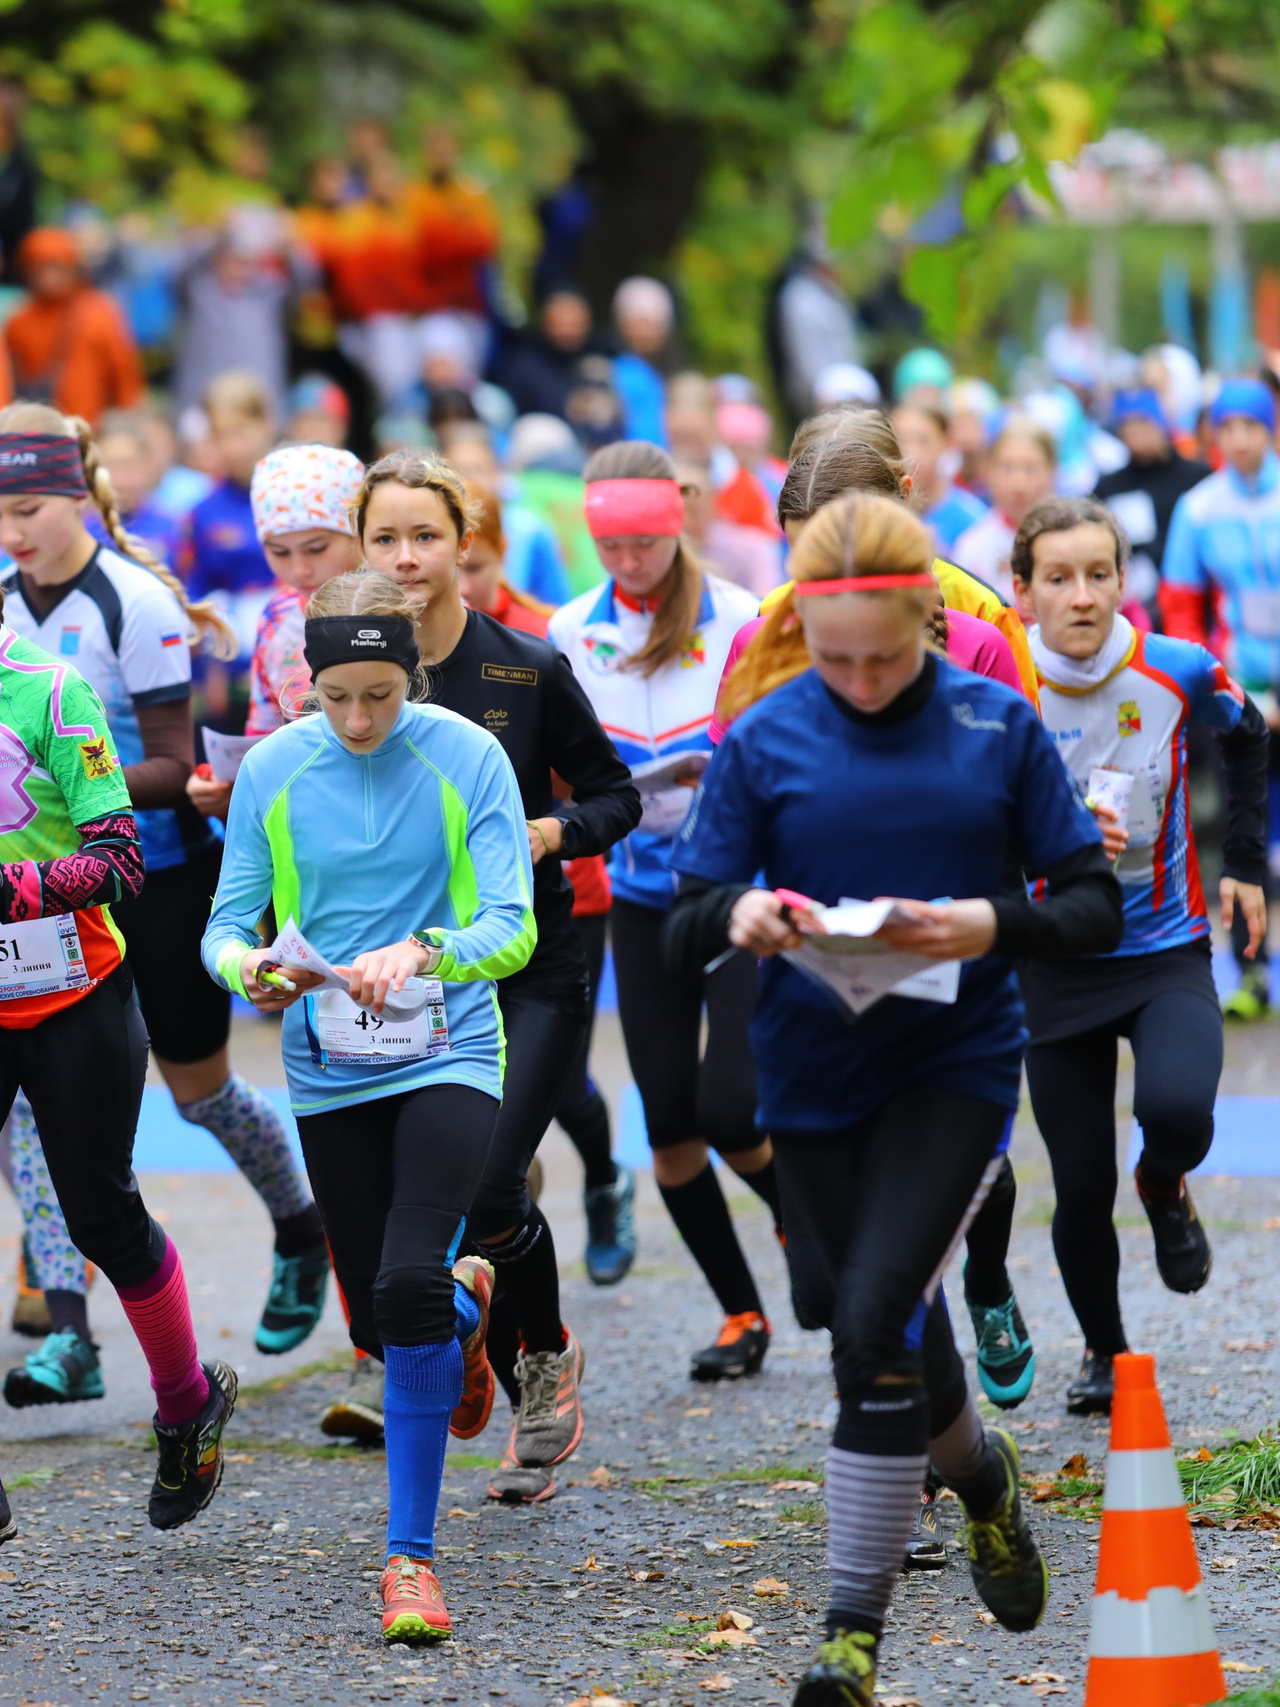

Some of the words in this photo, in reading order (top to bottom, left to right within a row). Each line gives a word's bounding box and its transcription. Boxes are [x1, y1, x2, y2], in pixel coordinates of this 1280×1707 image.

[350, 639, 387, 649] Kalenji
[59, 926, 76, 935] evo
[13, 965, 19, 973] 3
[20, 962, 52, 973] линия
[3, 984, 26, 993] РОССИИ
[15, 984, 61, 999] СОРЕВНОВАНИЯ
[354, 1010, 384, 1031] 49
[370, 1035, 376, 1044] 3
